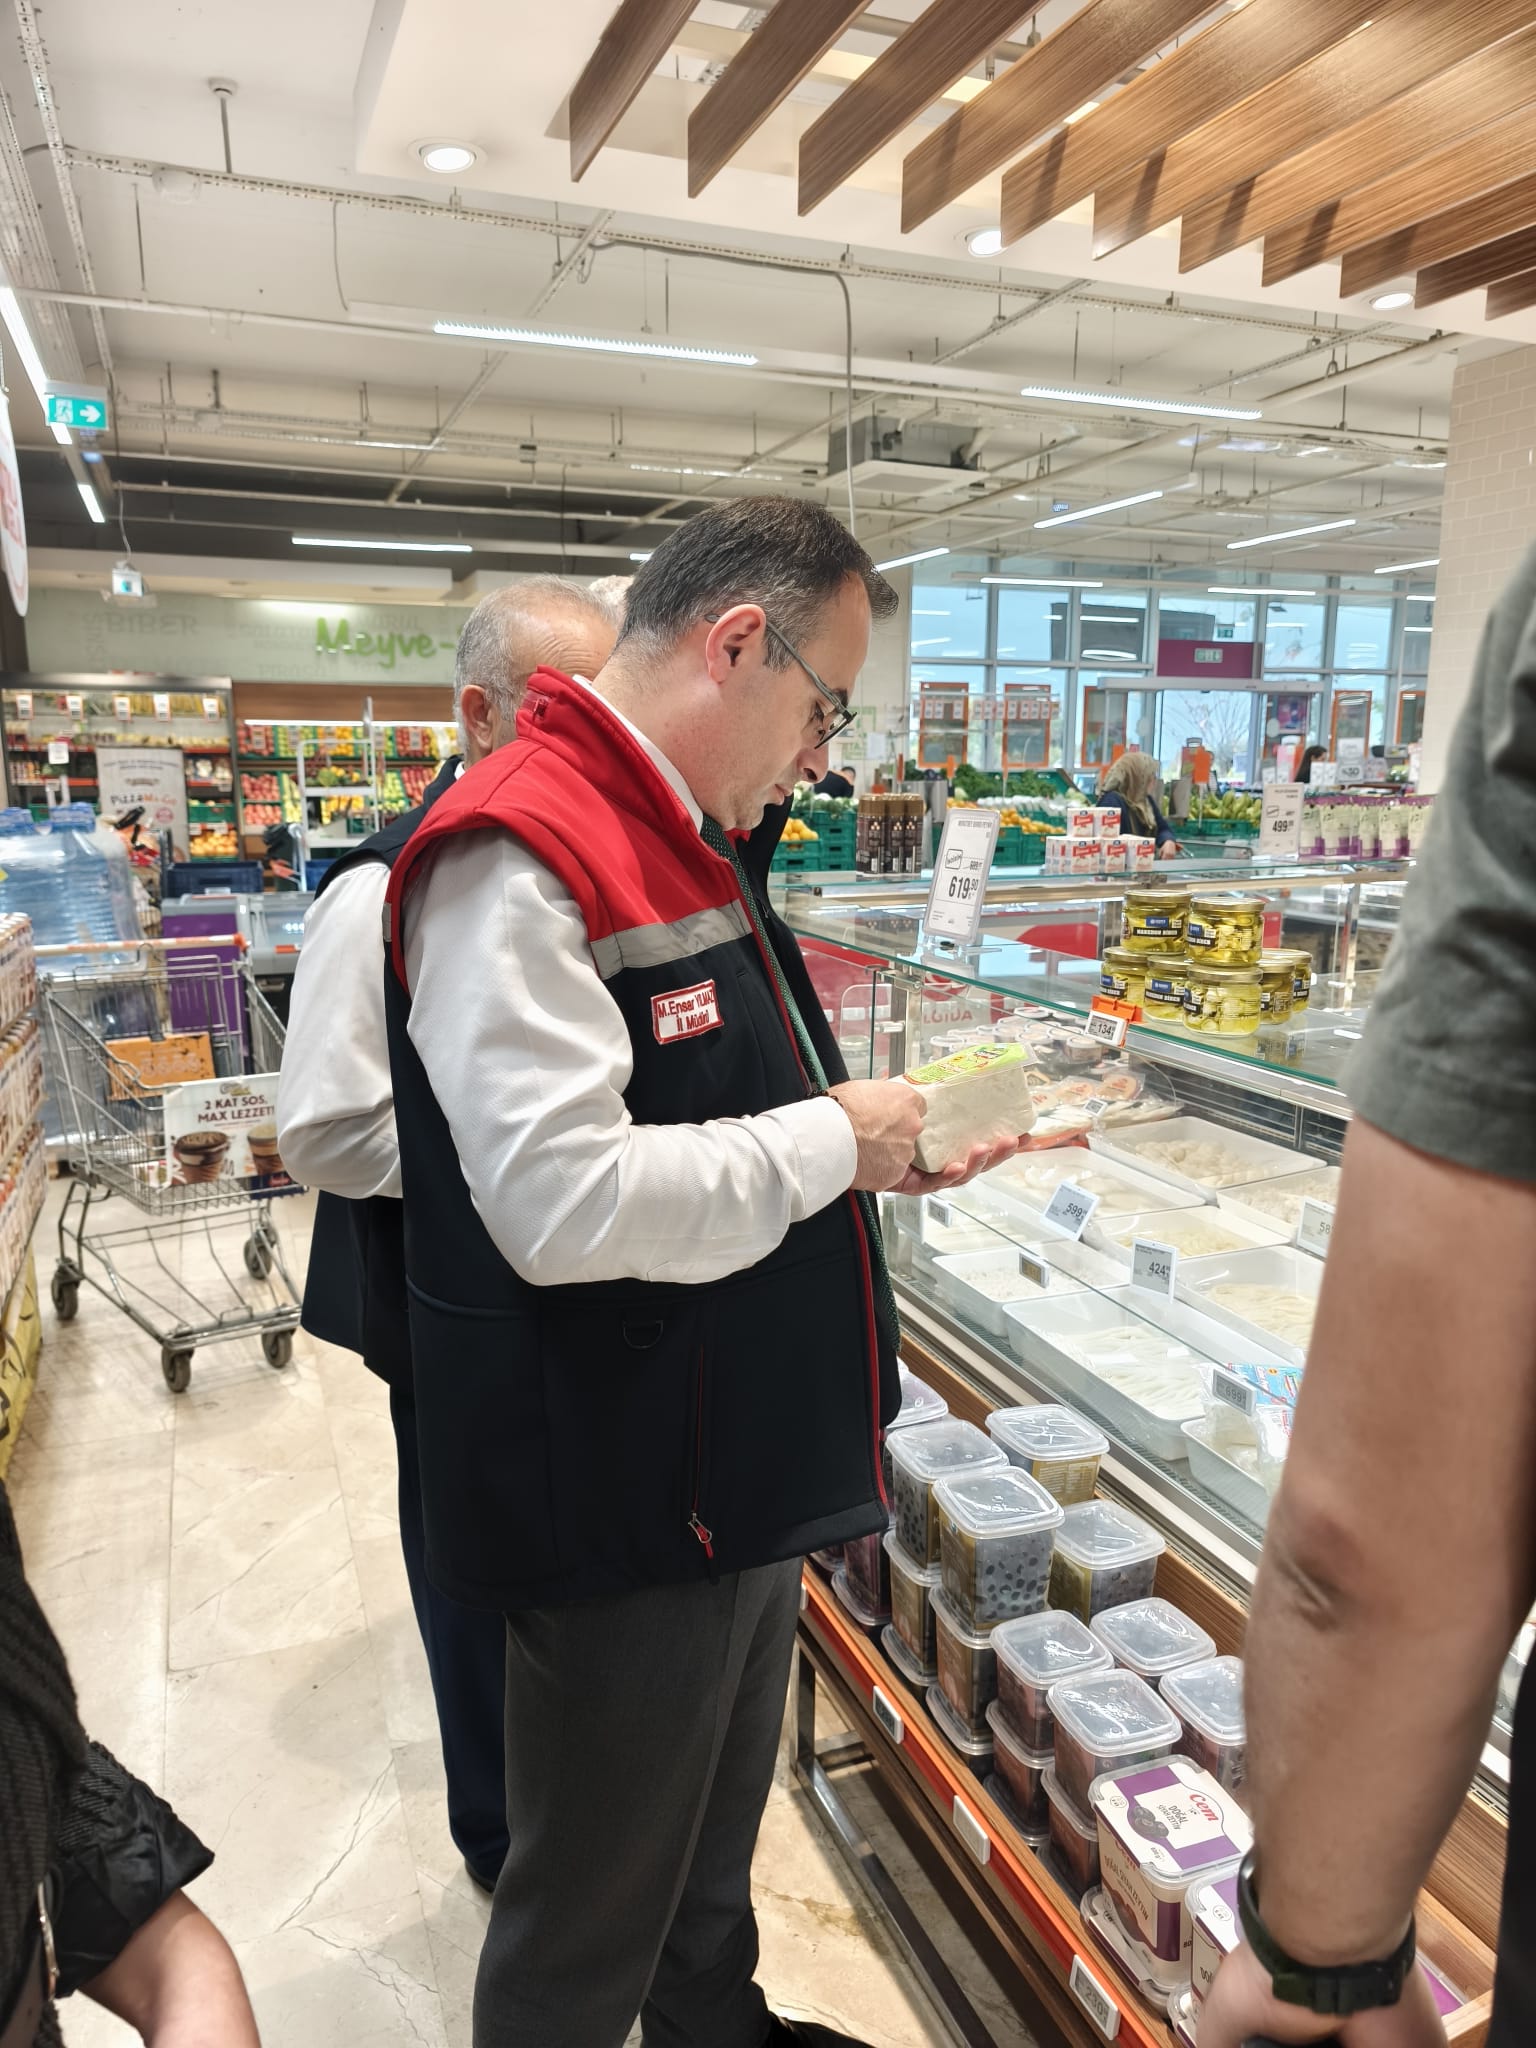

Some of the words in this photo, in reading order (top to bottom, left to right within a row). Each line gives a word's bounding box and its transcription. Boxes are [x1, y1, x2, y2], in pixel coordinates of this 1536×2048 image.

[316, 617, 462, 670] Meyve-
[197, 1111, 228, 1123] MAX
[231, 1106, 275, 1120] LEZZET!
[215, 1099, 237, 1109] KAT
[1189, 1794, 1219, 1822] Cem
